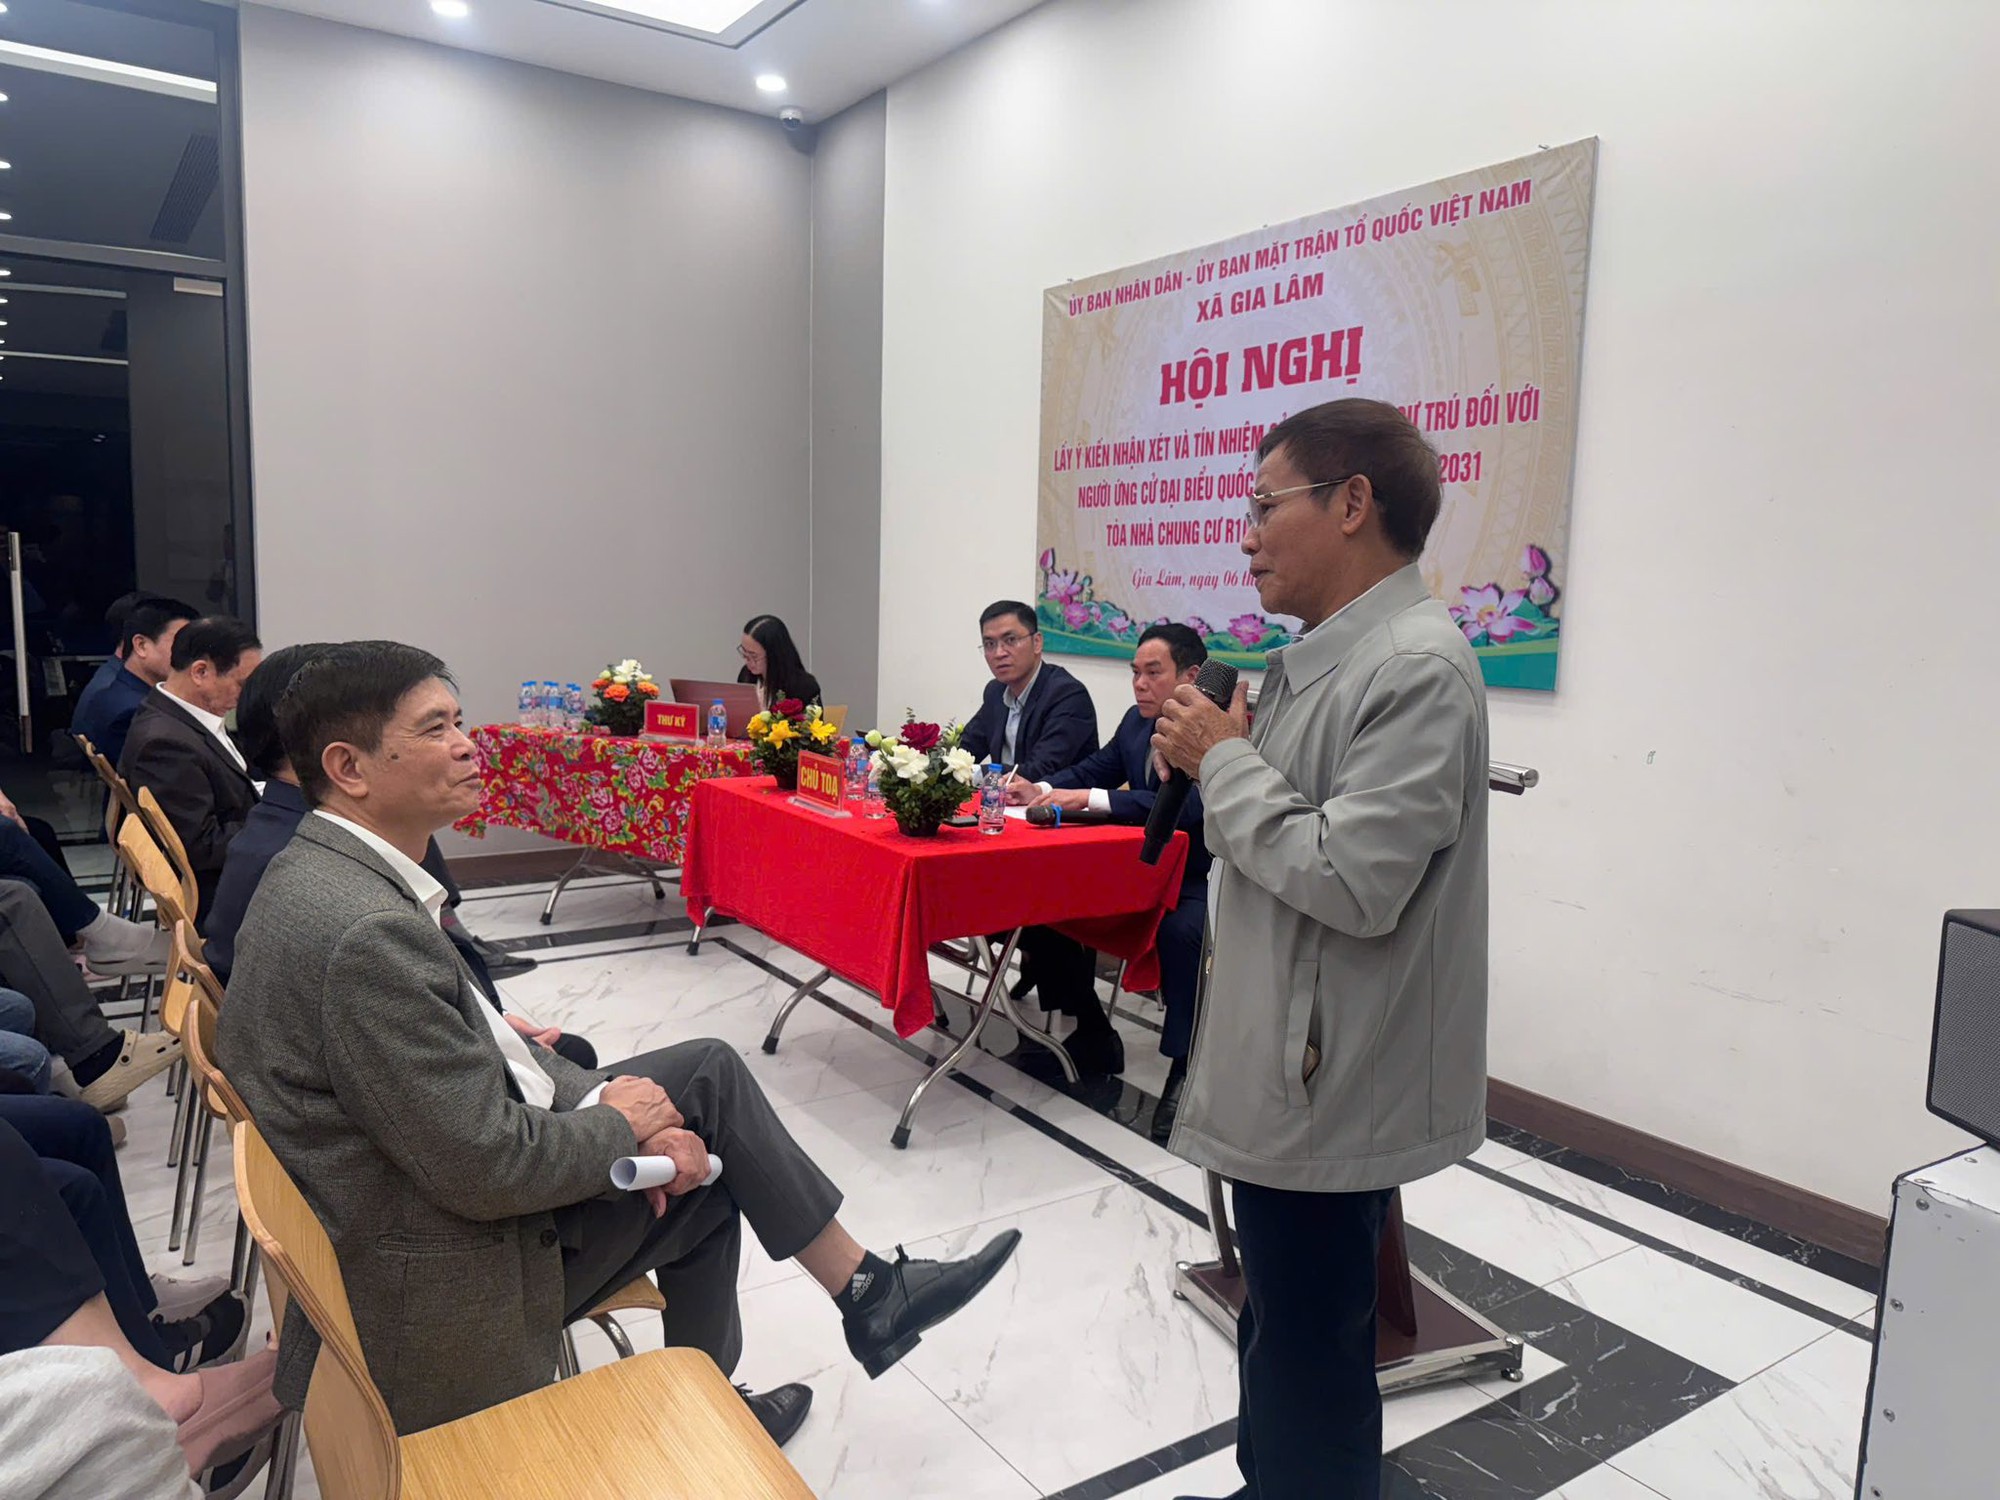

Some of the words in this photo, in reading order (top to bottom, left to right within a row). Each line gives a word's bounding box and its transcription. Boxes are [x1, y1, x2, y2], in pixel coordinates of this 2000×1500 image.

[1069, 293, 1084, 317] ỦY
[1086, 290, 1112, 313] BAN
[1115, 278, 1151, 306] NHÂN
[1154, 270, 1182, 296] DÂN
[1196, 258, 1215, 285] ỦY
[1218, 253, 1250, 280] BAN
[1254, 240, 1289, 271] MẶT
[1294, 229, 1339, 260] TRẬN
[1344, 213, 1368, 247] TỔ
[1371, 202, 1423, 242] QUỐC
[1429, 193, 1473, 227] VIỆT
[1478, 179, 1532, 215] NAM
[1196, 293, 1223, 323] XÃ
[1230, 286, 1266, 315] GIA
[1273, 273, 1324, 306] LÂM
[1159, 347, 1229, 410] HỘI
[1241, 326, 1364, 386] NGHỊ
[1054, 440, 1073, 471] LẤY
[1075, 442, 1082, 470] Ý
[1084, 437, 1110, 469] KIẾN
[1113, 435, 1146, 470] NHẬN
[1148, 432, 1171, 463] XÉT
[1174, 428, 1190, 459] VÀ
[1194, 426, 1215, 457] TÍN
[1218, 420, 1264, 459] NHIỆM
[1425, 393, 1460, 432] TRÚ
[1466, 383, 1500, 428] ĐỐI
[1507, 383, 1540, 424] VỚI
[1078, 479, 1111, 508] NGƯỜI
[1114, 478, 1138, 506] ỨNG
[1141, 472, 1158, 505] CỬ
[1160, 480, 1181, 508] ĐẠI
[1184, 465, 1214, 501] BIỂU
[1218, 462, 1254, 502] QUỐC
[1440, 451, 1481, 483] 2031
[1106, 518, 1127, 547] TÒA
[1130, 517, 1154, 546] NHÀ
[1158, 519, 1200, 546] CHUNG
[1204, 516, 1223, 544] CƯ
[1132, 568, 1153, 591] Gia
[1189, 570, 1219, 590] ngày
[1223, 570, 1239, 587] 06
[657, 714, 674, 726] THƯ
[674, 714, 686, 727] KÝ
[800, 762, 819, 790] CHỦ
[821, 772, 838, 801] TOẠ
[852, 1271, 875, 1302] adidas
